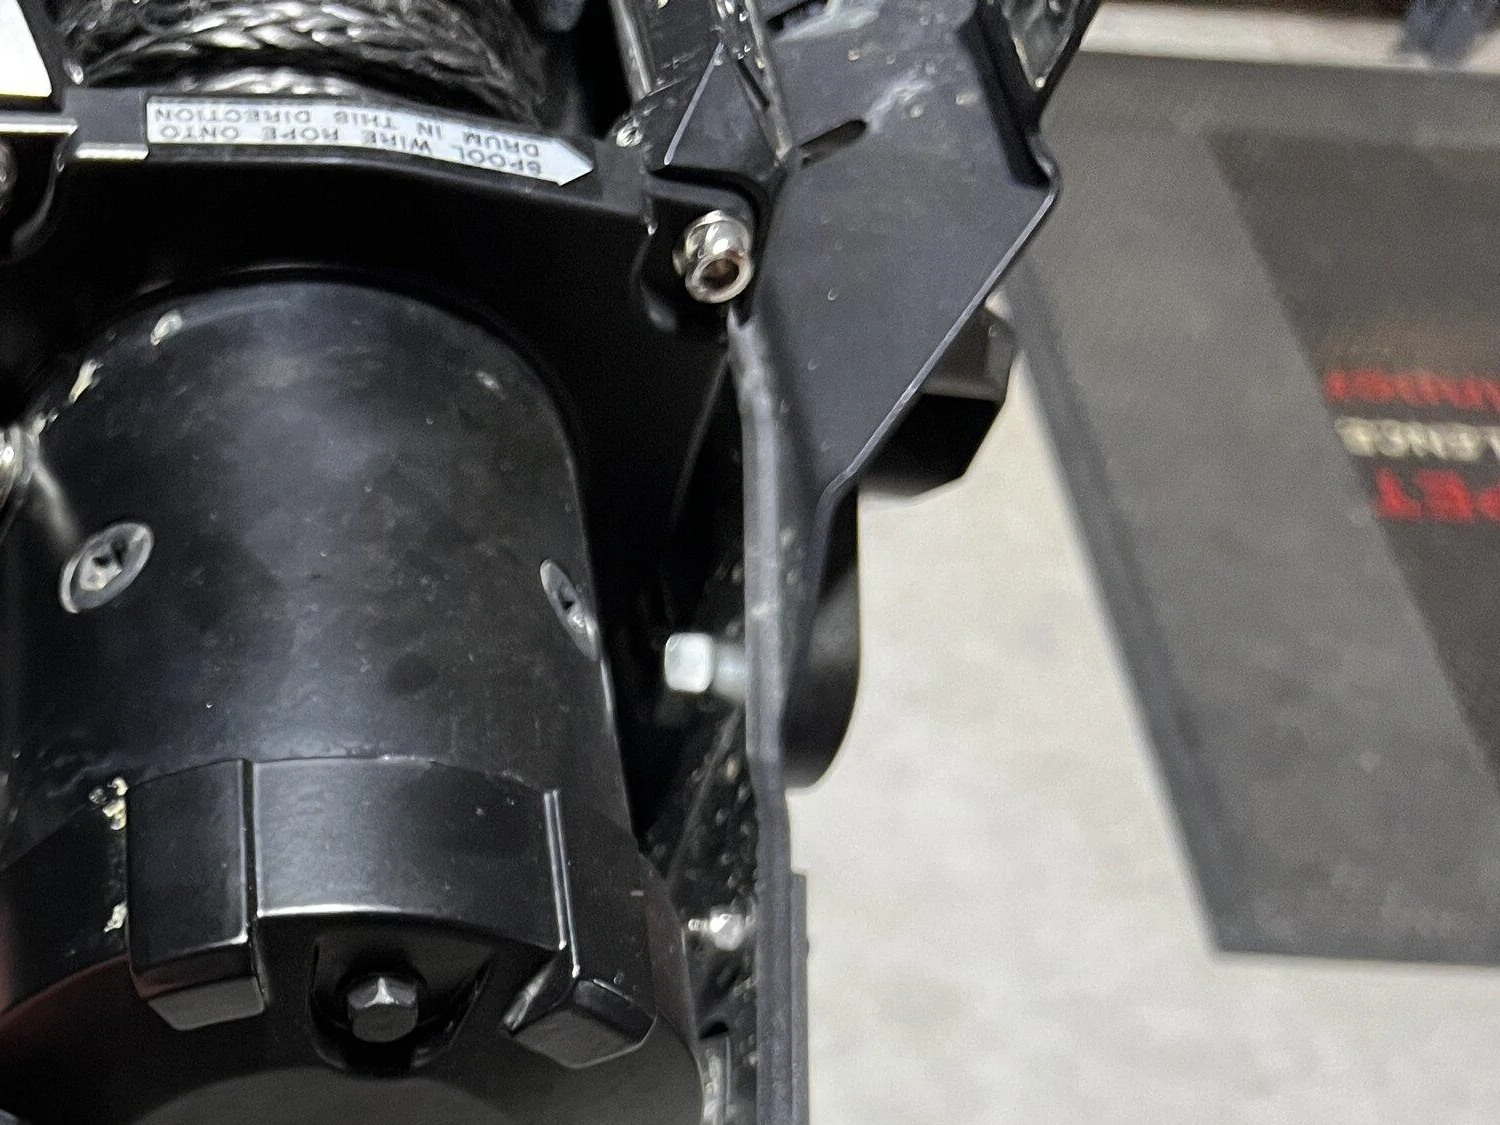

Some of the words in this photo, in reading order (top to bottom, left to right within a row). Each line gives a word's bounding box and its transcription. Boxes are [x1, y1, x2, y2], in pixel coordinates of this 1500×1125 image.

[154, 108, 311, 124] DIRECTION
[334, 110, 396, 129] THIS
[160, 125, 240, 141] ONTO
[261, 126, 339, 141] ROPE
[416, 121, 443, 140] IN
[363, 129, 433, 155] WIRE
[463, 131, 540, 157] DRUM
[451, 144, 542, 175] SPOOL
